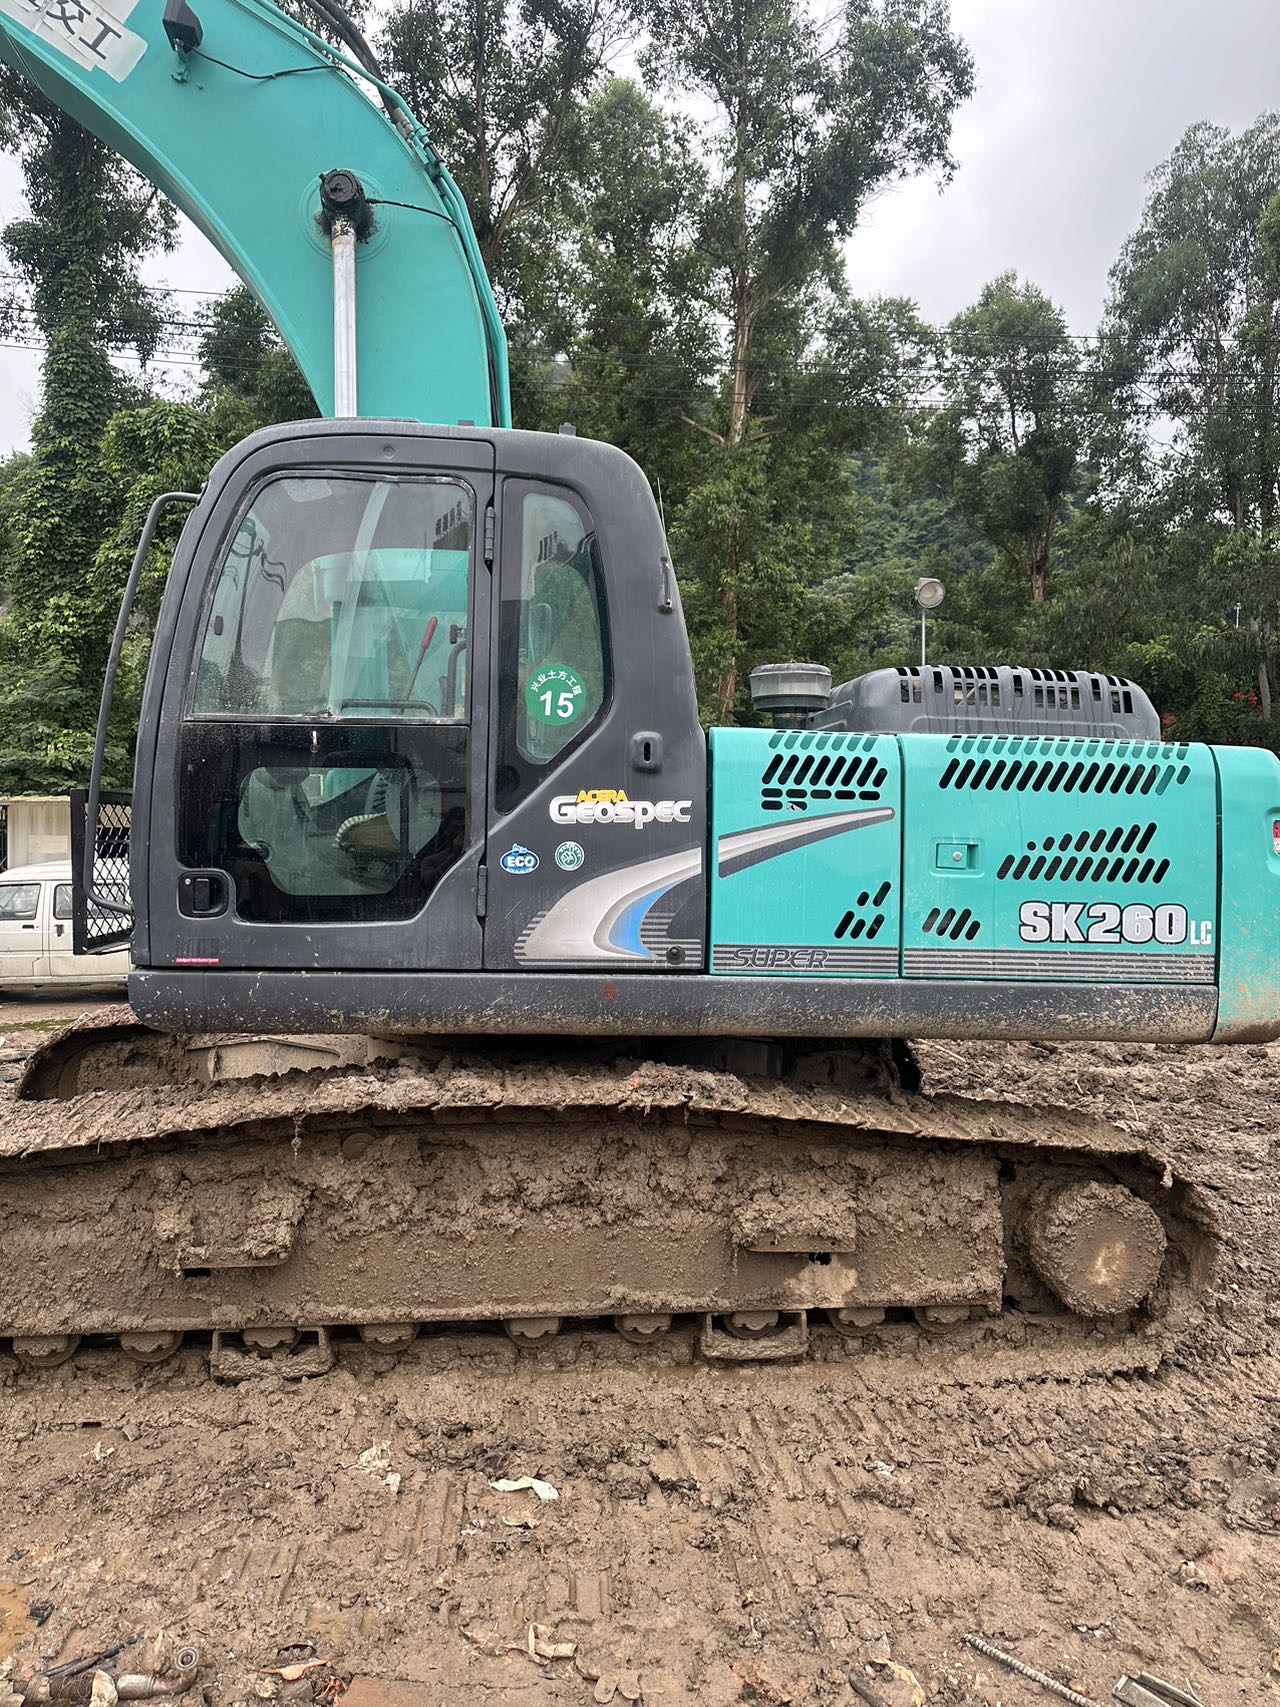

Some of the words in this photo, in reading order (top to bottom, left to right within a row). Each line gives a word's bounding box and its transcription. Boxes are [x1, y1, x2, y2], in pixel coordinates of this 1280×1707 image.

[28, 0, 121, 59] 交工
[540, 691, 574, 718] 15
[576, 789, 629, 803] ACERA
[507, 856, 535, 867] ECO
[1019, 901, 1188, 944] SK260
[1190, 920, 1212, 944] LC
[733, 948, 829, 969] SUPER
